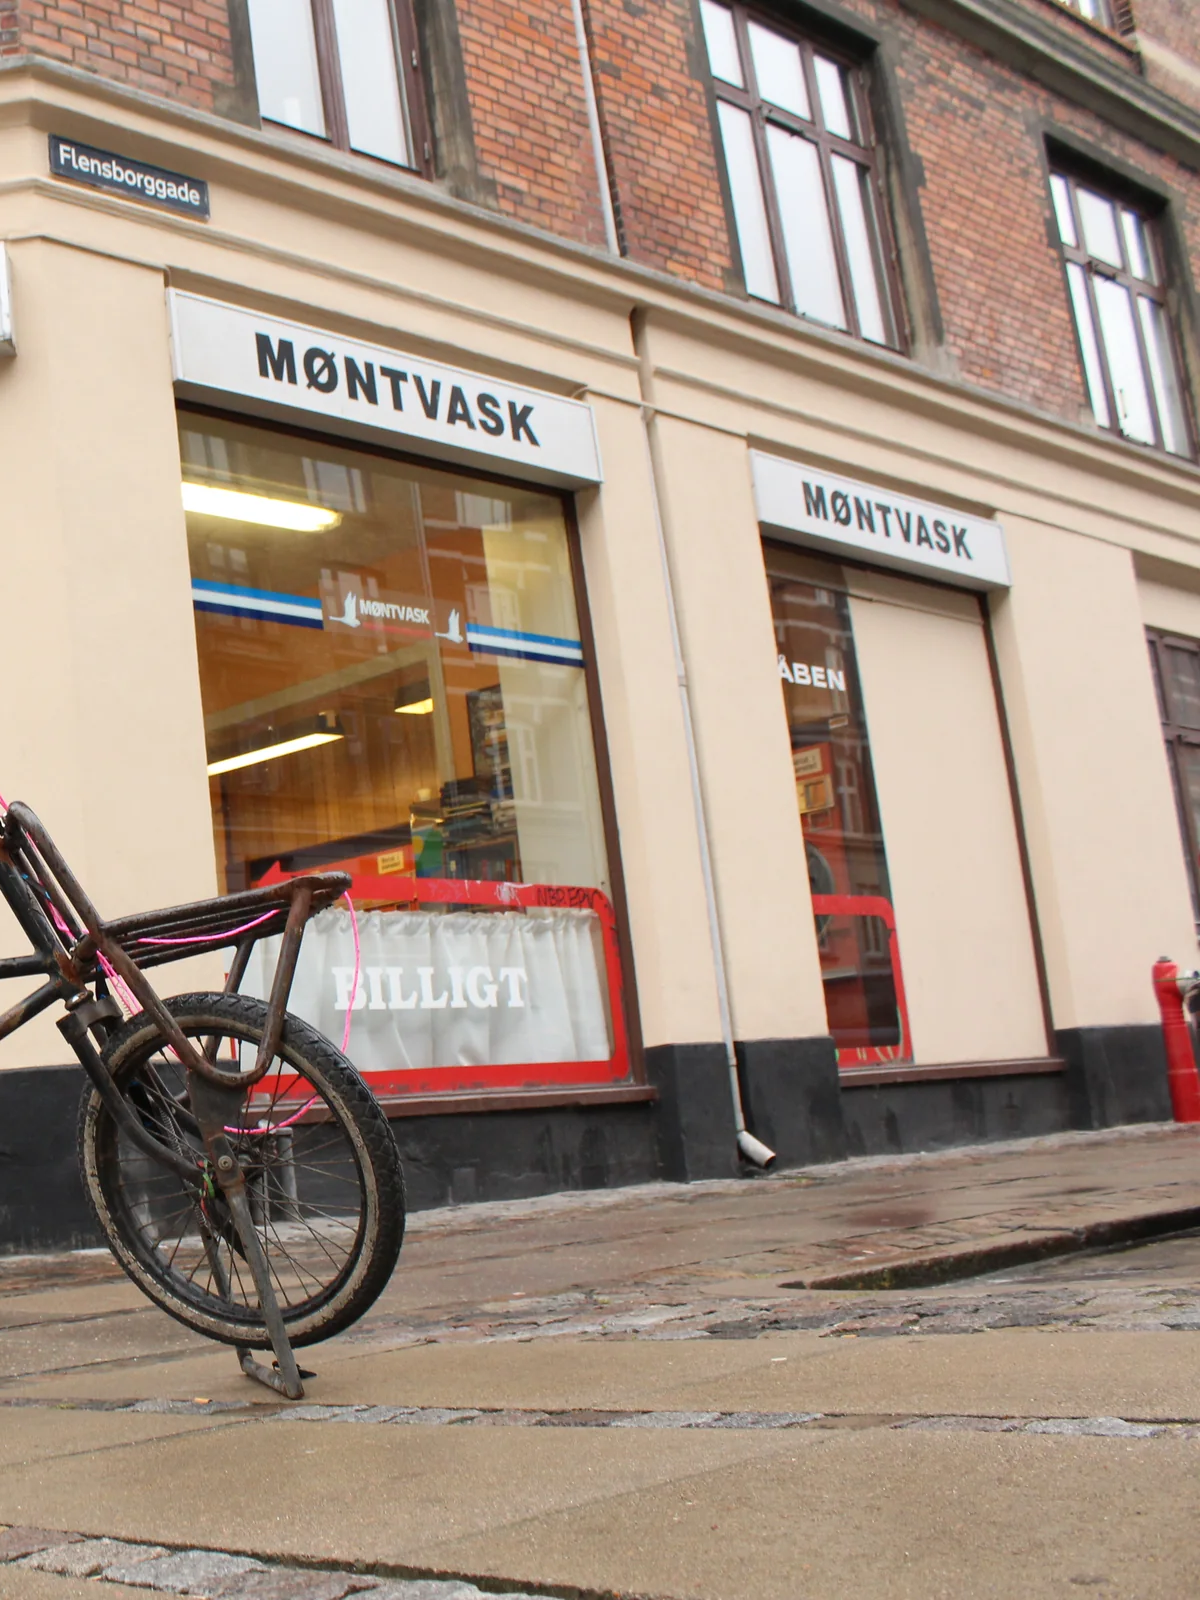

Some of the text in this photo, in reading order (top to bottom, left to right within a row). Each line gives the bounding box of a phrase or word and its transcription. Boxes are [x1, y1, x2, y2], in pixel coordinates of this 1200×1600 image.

[59, 143, 201, 206] Flensborggade
[255, 331, 540, 447] MØNTVASK
[802, 481, 973, 561] MØNTVASK
[359, 599, 430, 624] MØNTVASK
[778, 654, 846, 691] ÅBEN
[331, 966, 528, 1010] BILLIGT
